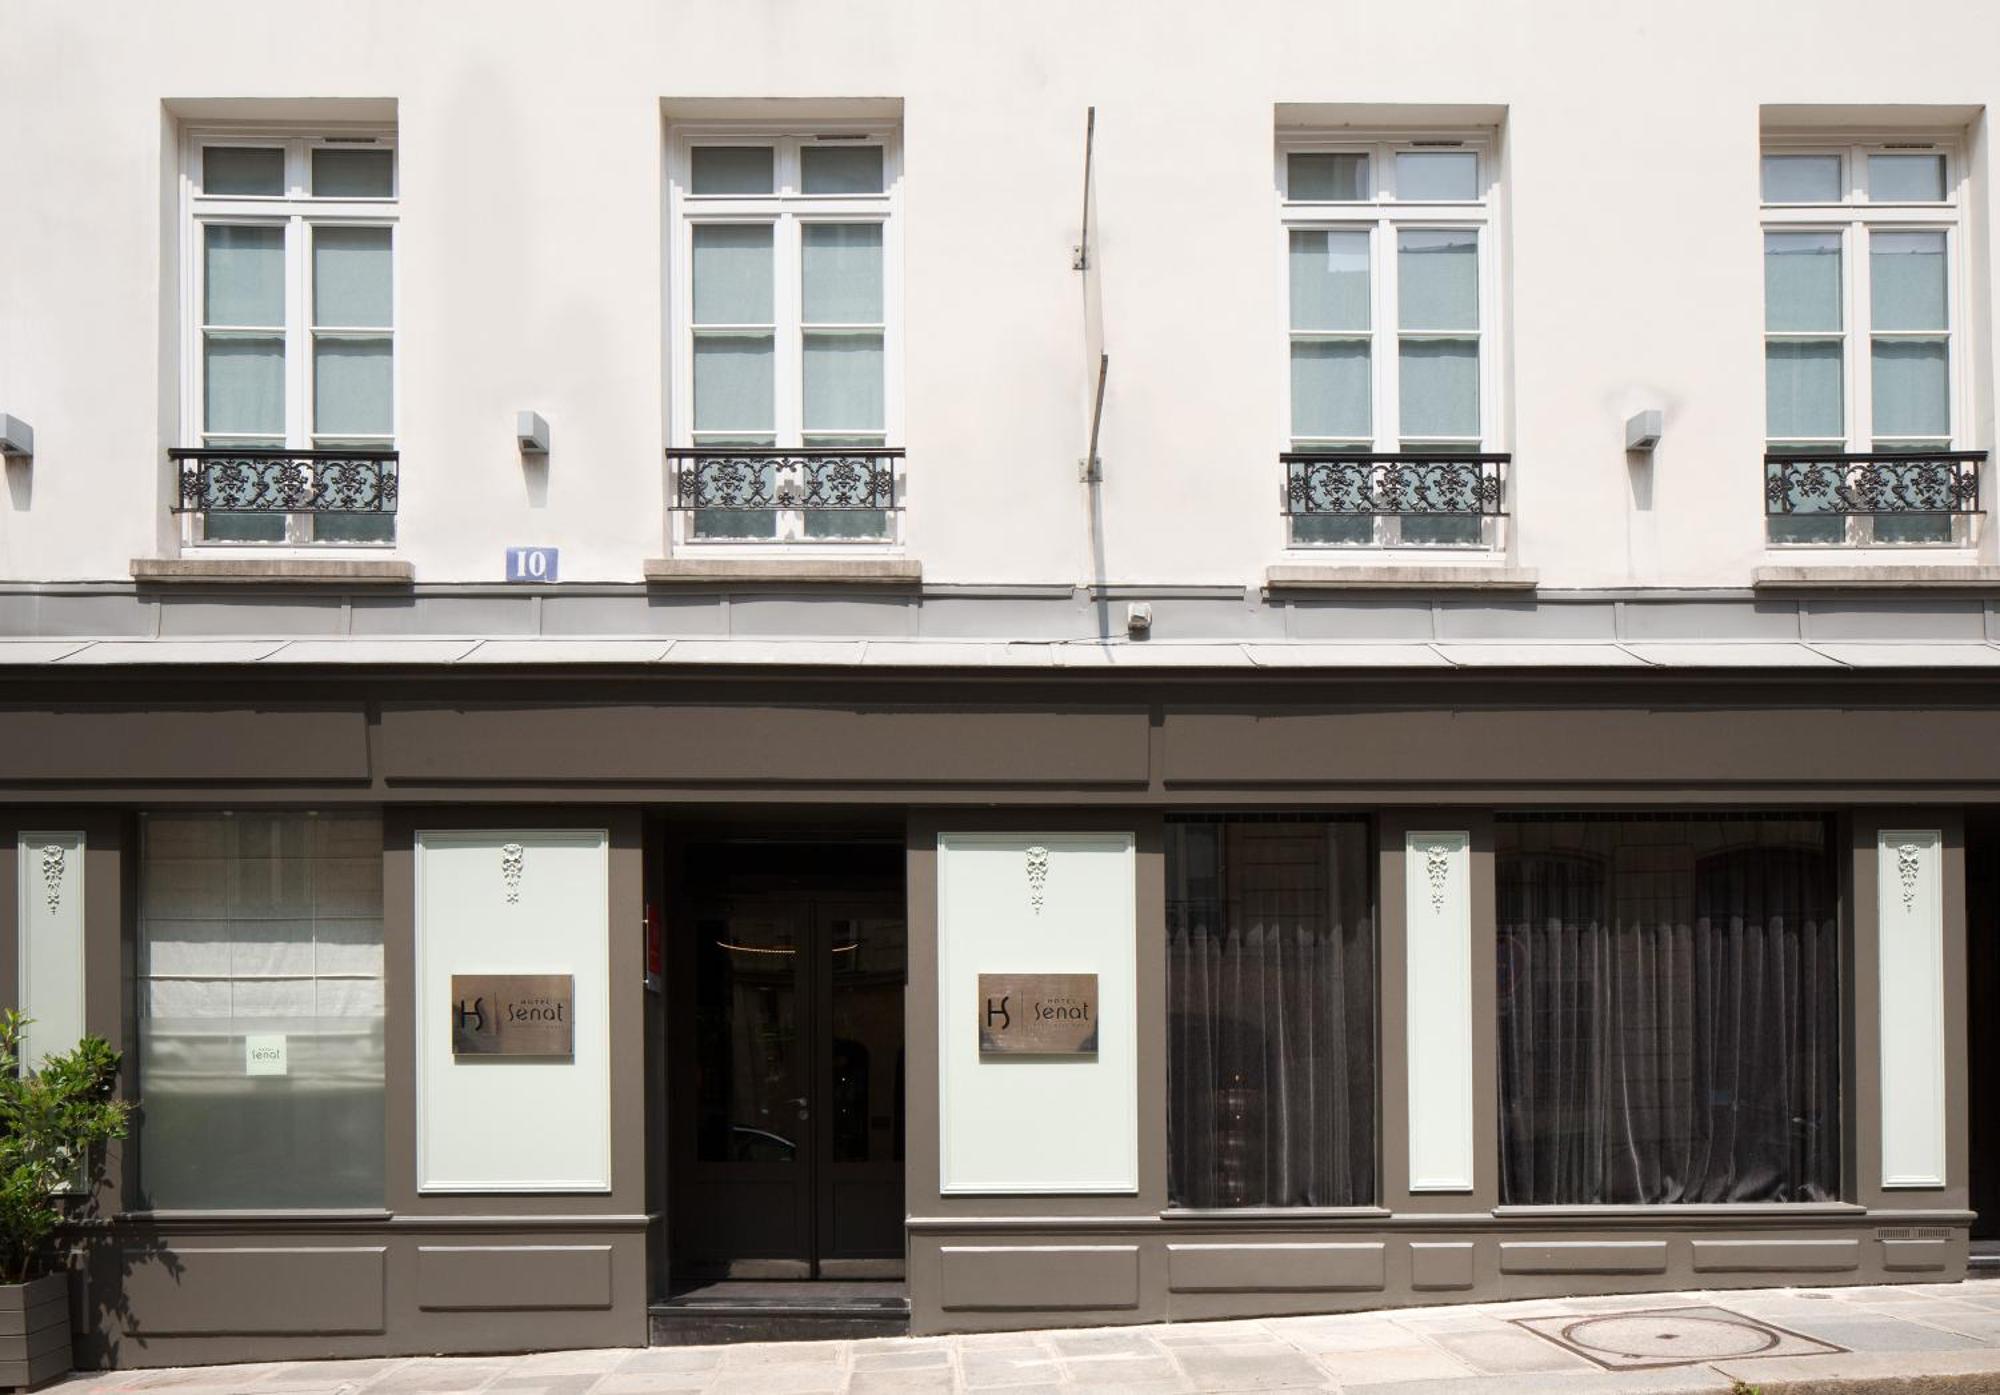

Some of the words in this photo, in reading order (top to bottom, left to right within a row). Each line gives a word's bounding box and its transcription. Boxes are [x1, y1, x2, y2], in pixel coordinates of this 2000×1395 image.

[517, 551, 546, 577] 10
[508, 1002, 563, 1021] Senat
[1034, 1002, 1088, 1021] Senat
